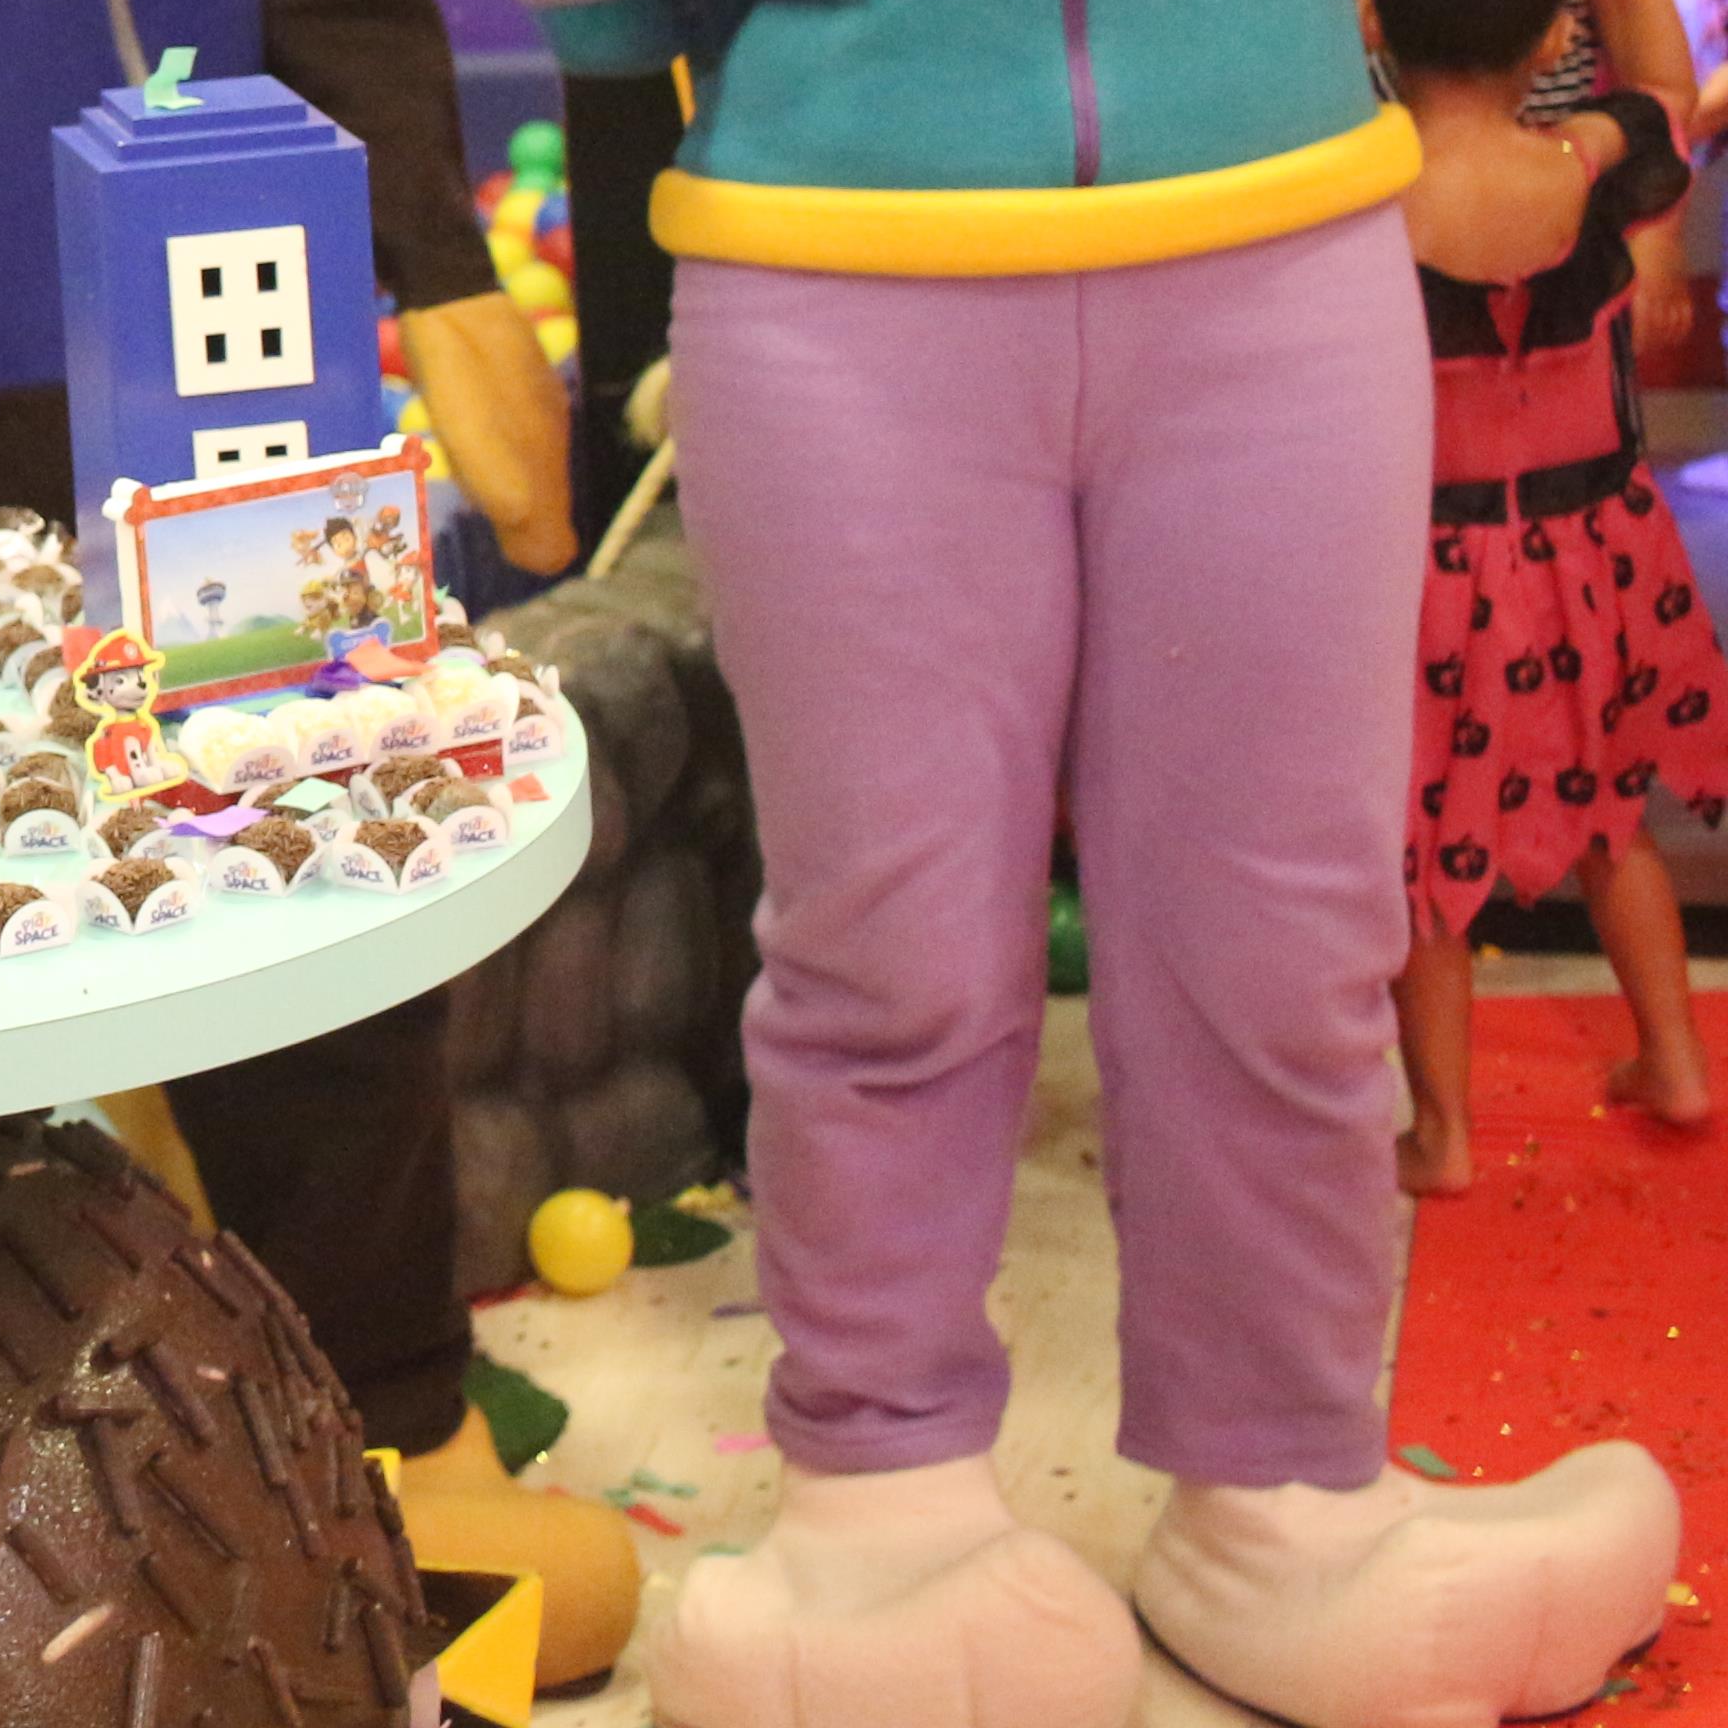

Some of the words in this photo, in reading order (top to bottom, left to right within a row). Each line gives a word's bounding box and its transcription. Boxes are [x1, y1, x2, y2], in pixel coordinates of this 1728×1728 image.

[453, 721, 501, 738] SPACE
[381, 734, 431, 751] SPACE
[508, 736, 549, 753] SPACE
[311, 747, 353, 766] SPACE
[234, 767, 285, 784] SPACE
[21, 834, 68, 849] SPACE
[340, 864, 384, 882] SPACE
[409, 864, 442, 882] SPACE
[223, 874, 269, 890] SPACE
[150, 903, 188, 924] SPACE
[14, 924, 60, 946] SPACE
